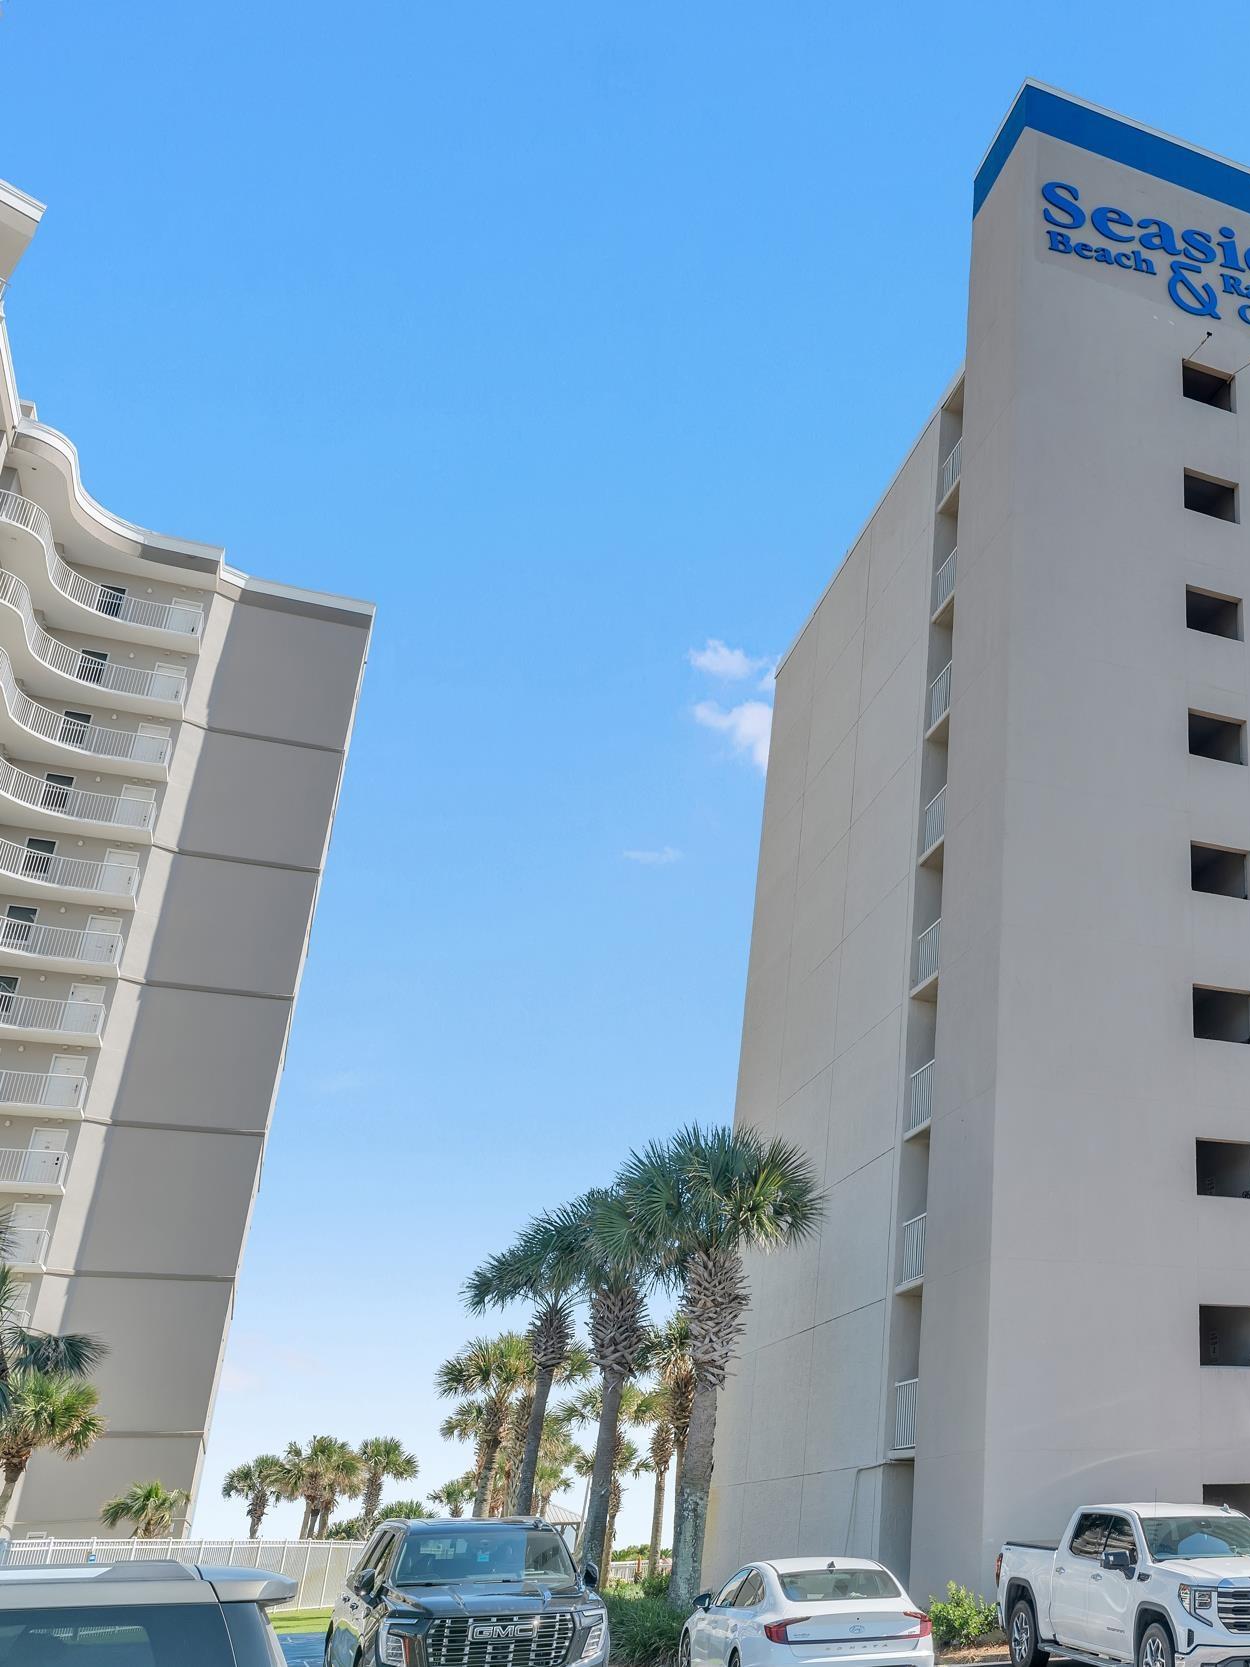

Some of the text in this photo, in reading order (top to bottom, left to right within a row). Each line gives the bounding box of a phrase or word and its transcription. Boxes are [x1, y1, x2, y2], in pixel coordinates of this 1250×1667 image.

[1046, 230, 1157, 276] Beach
[1168, 260, 1221, 320] &
[473, 1624, 534, 1639] GMC
